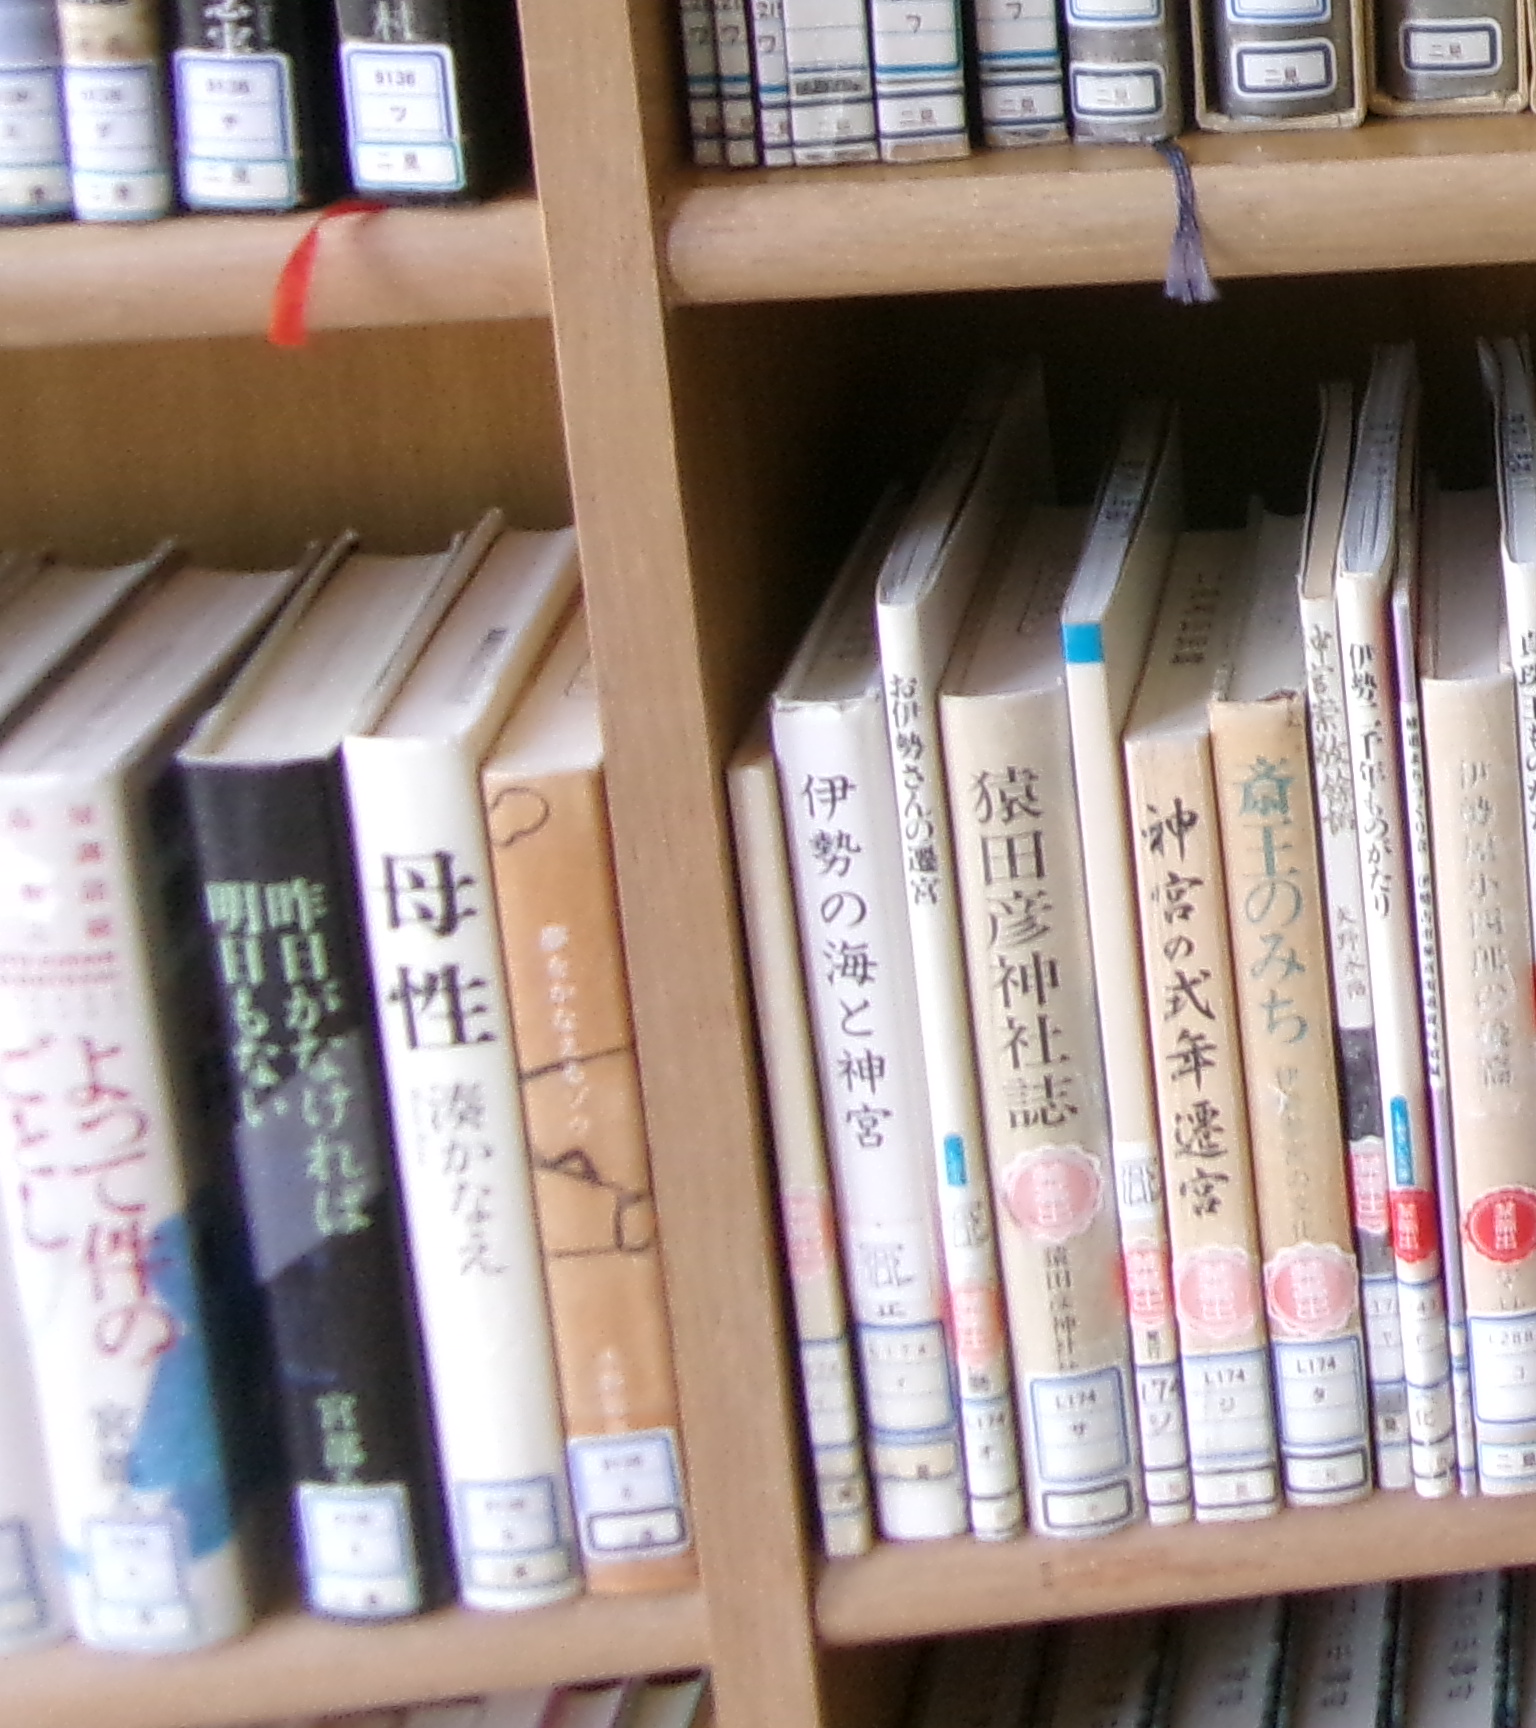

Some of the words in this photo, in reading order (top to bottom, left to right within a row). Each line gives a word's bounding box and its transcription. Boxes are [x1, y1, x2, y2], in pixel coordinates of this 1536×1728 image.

[381, 849, 497, 1052] 母性
[800, 771, 895, 1152] 伊勢の海と神宮
[969, 764, 1081, 1131] 猿田彦神社誌
[1139, 794, 1231, 1219] 神宮の式年遷宮
